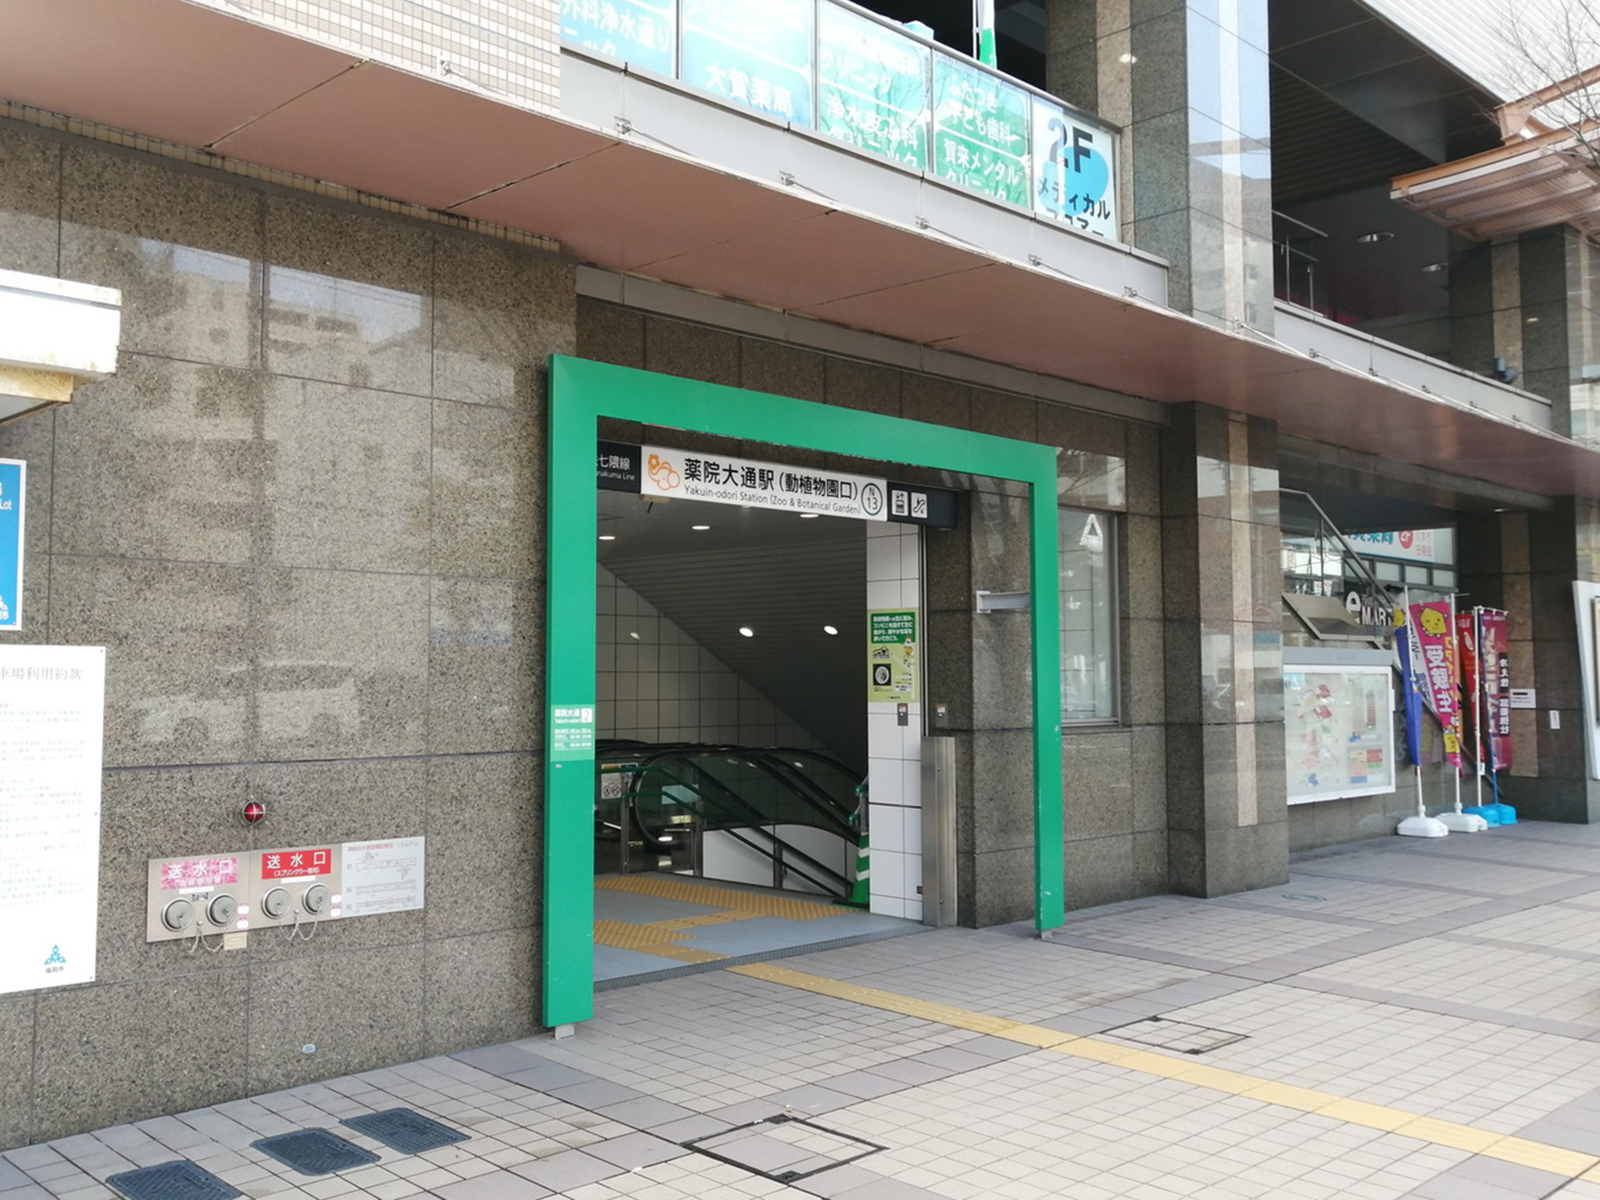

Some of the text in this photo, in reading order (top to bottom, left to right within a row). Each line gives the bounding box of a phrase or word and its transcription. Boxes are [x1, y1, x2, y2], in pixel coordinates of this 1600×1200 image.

[1048, 117, 1093, 173] 2F
[944, 138, 1019, 185] 賀来メンタル
[684, 485, 862, 515] Yakuin-odori Station (Zoo & Botanical Garden)
[869, 487, 875, 497] N
[867, 498, 878, 510] 13
[168, 860, 231, 879] 送水口
[267, 852, 326, 869] 送水口
